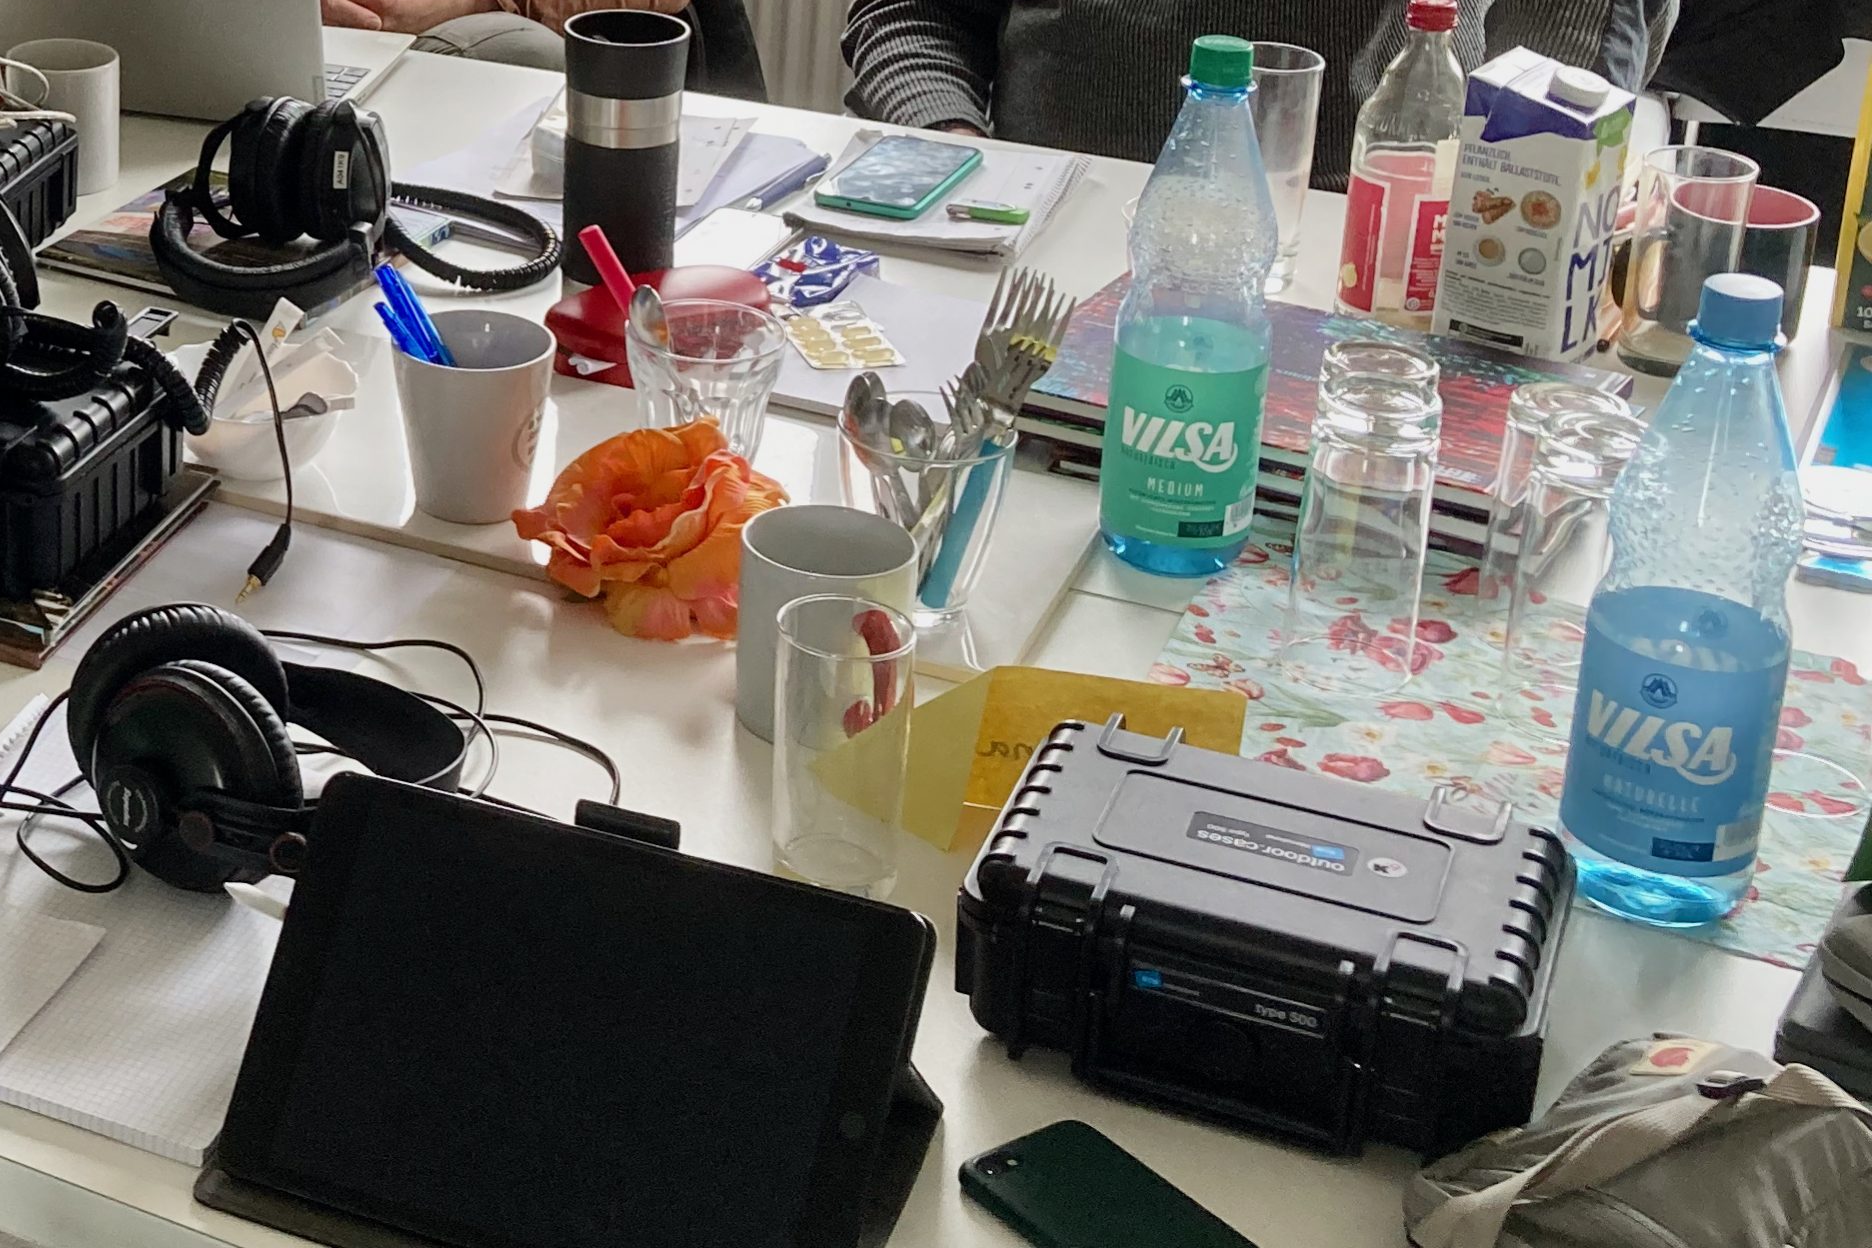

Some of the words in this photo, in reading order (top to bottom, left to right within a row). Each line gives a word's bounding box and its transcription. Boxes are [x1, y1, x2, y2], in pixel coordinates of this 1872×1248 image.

[1121, 405, 1238, 473] VILSA
[1147, 476, 1204, 497] MEDIUM
[1586, 688, 1736, 786] VILSA
[1197, 829, 1345, 872] outdoor.cases
